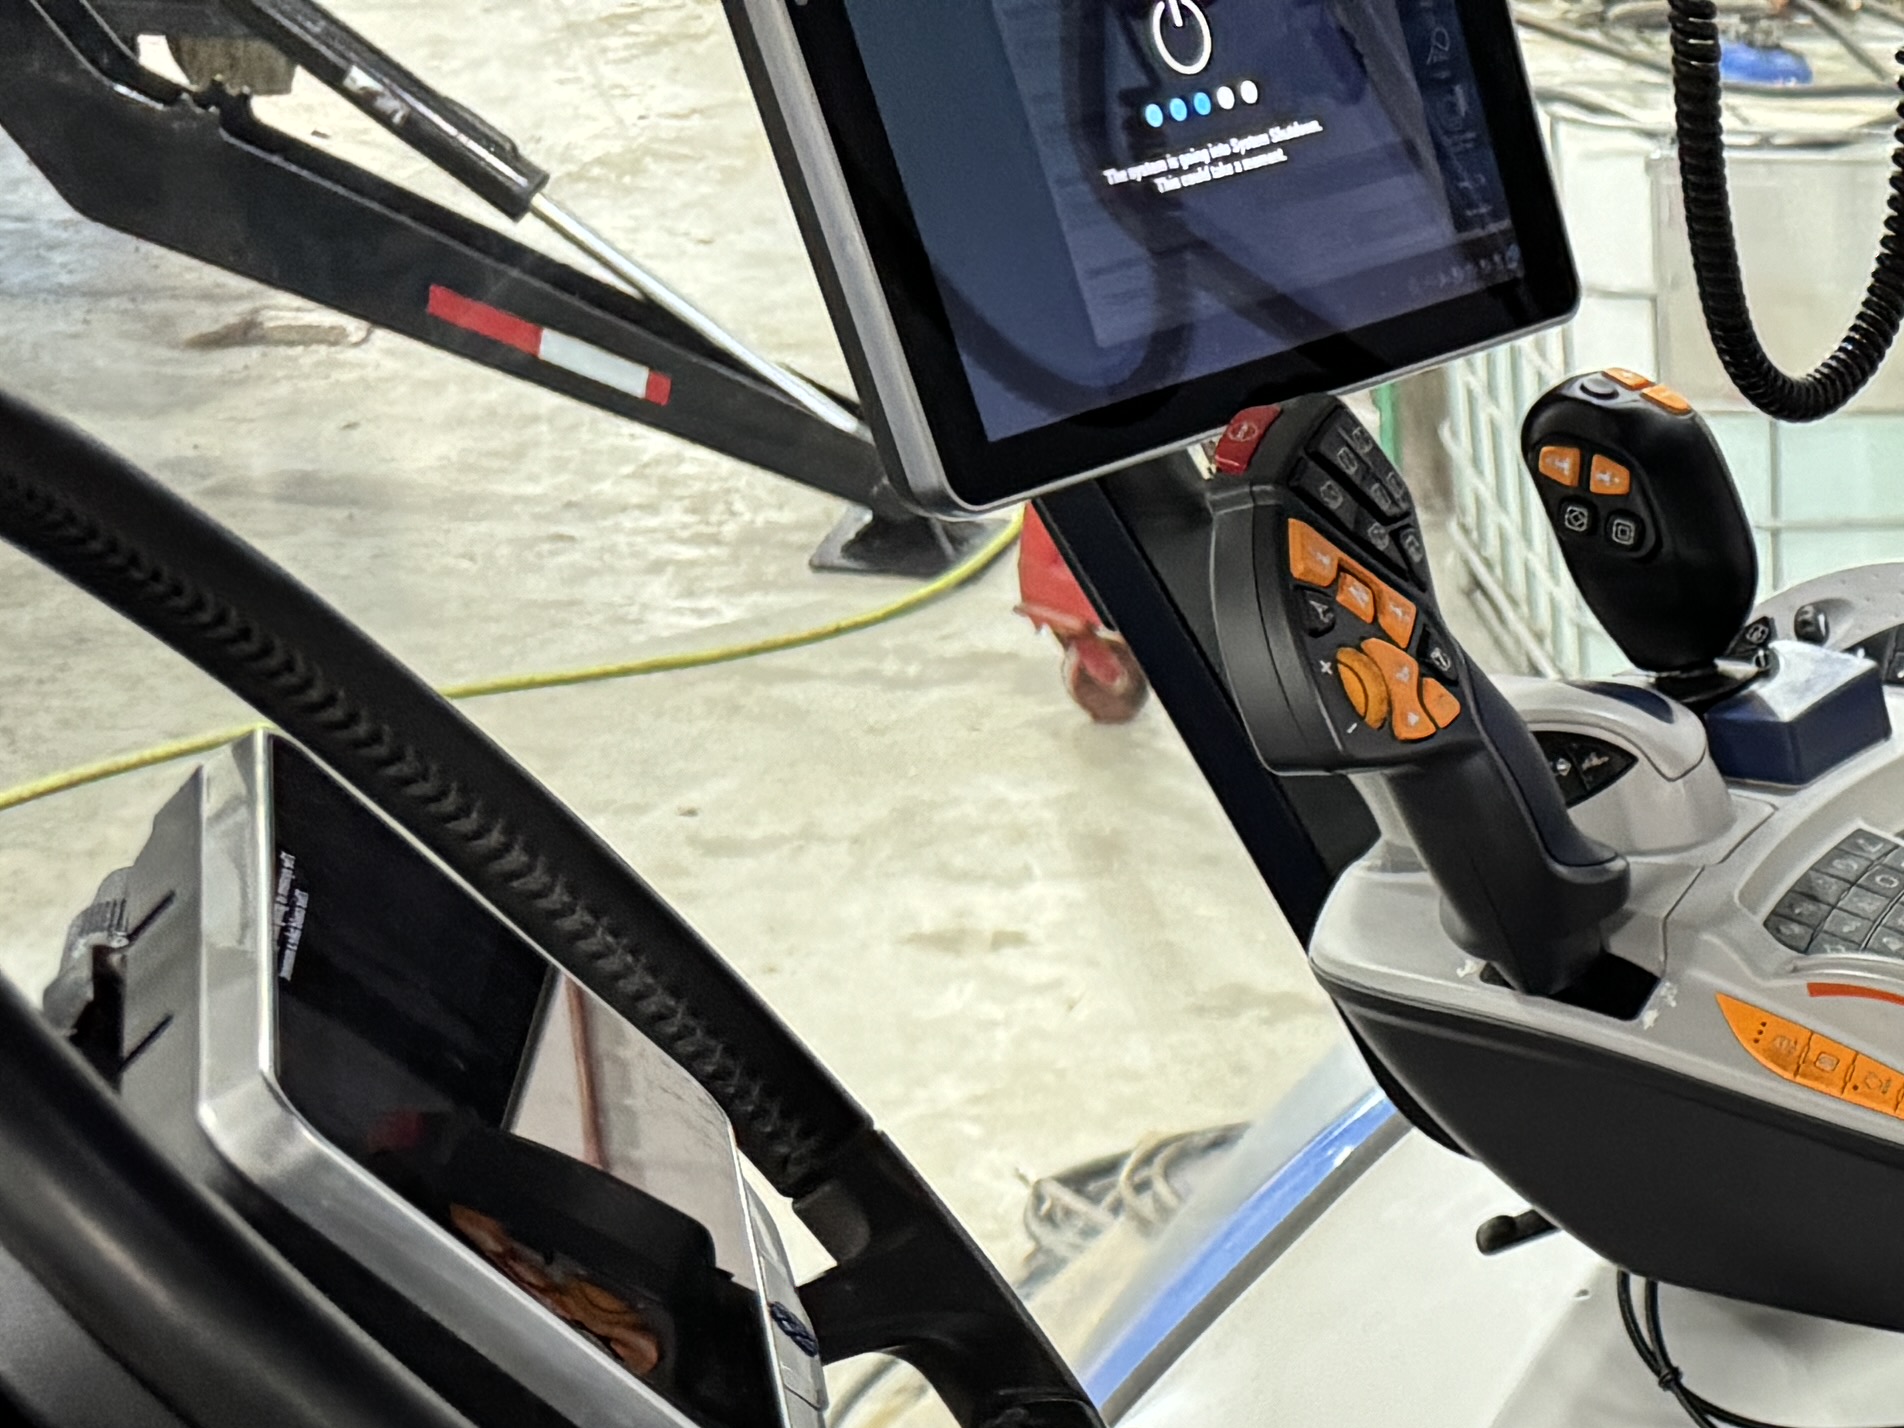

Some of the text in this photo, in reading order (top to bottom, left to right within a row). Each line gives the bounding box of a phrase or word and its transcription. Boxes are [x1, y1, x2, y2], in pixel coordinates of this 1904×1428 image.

[1103, 168, 1128, 185] The
[1127, 160, 1168, 182] system
[1166, 154, 1179, 169] is
[1179, 147, 1210, 170] going
[1230, 133, 1270, 155] System
[1154, 175, 1182, 193] This
